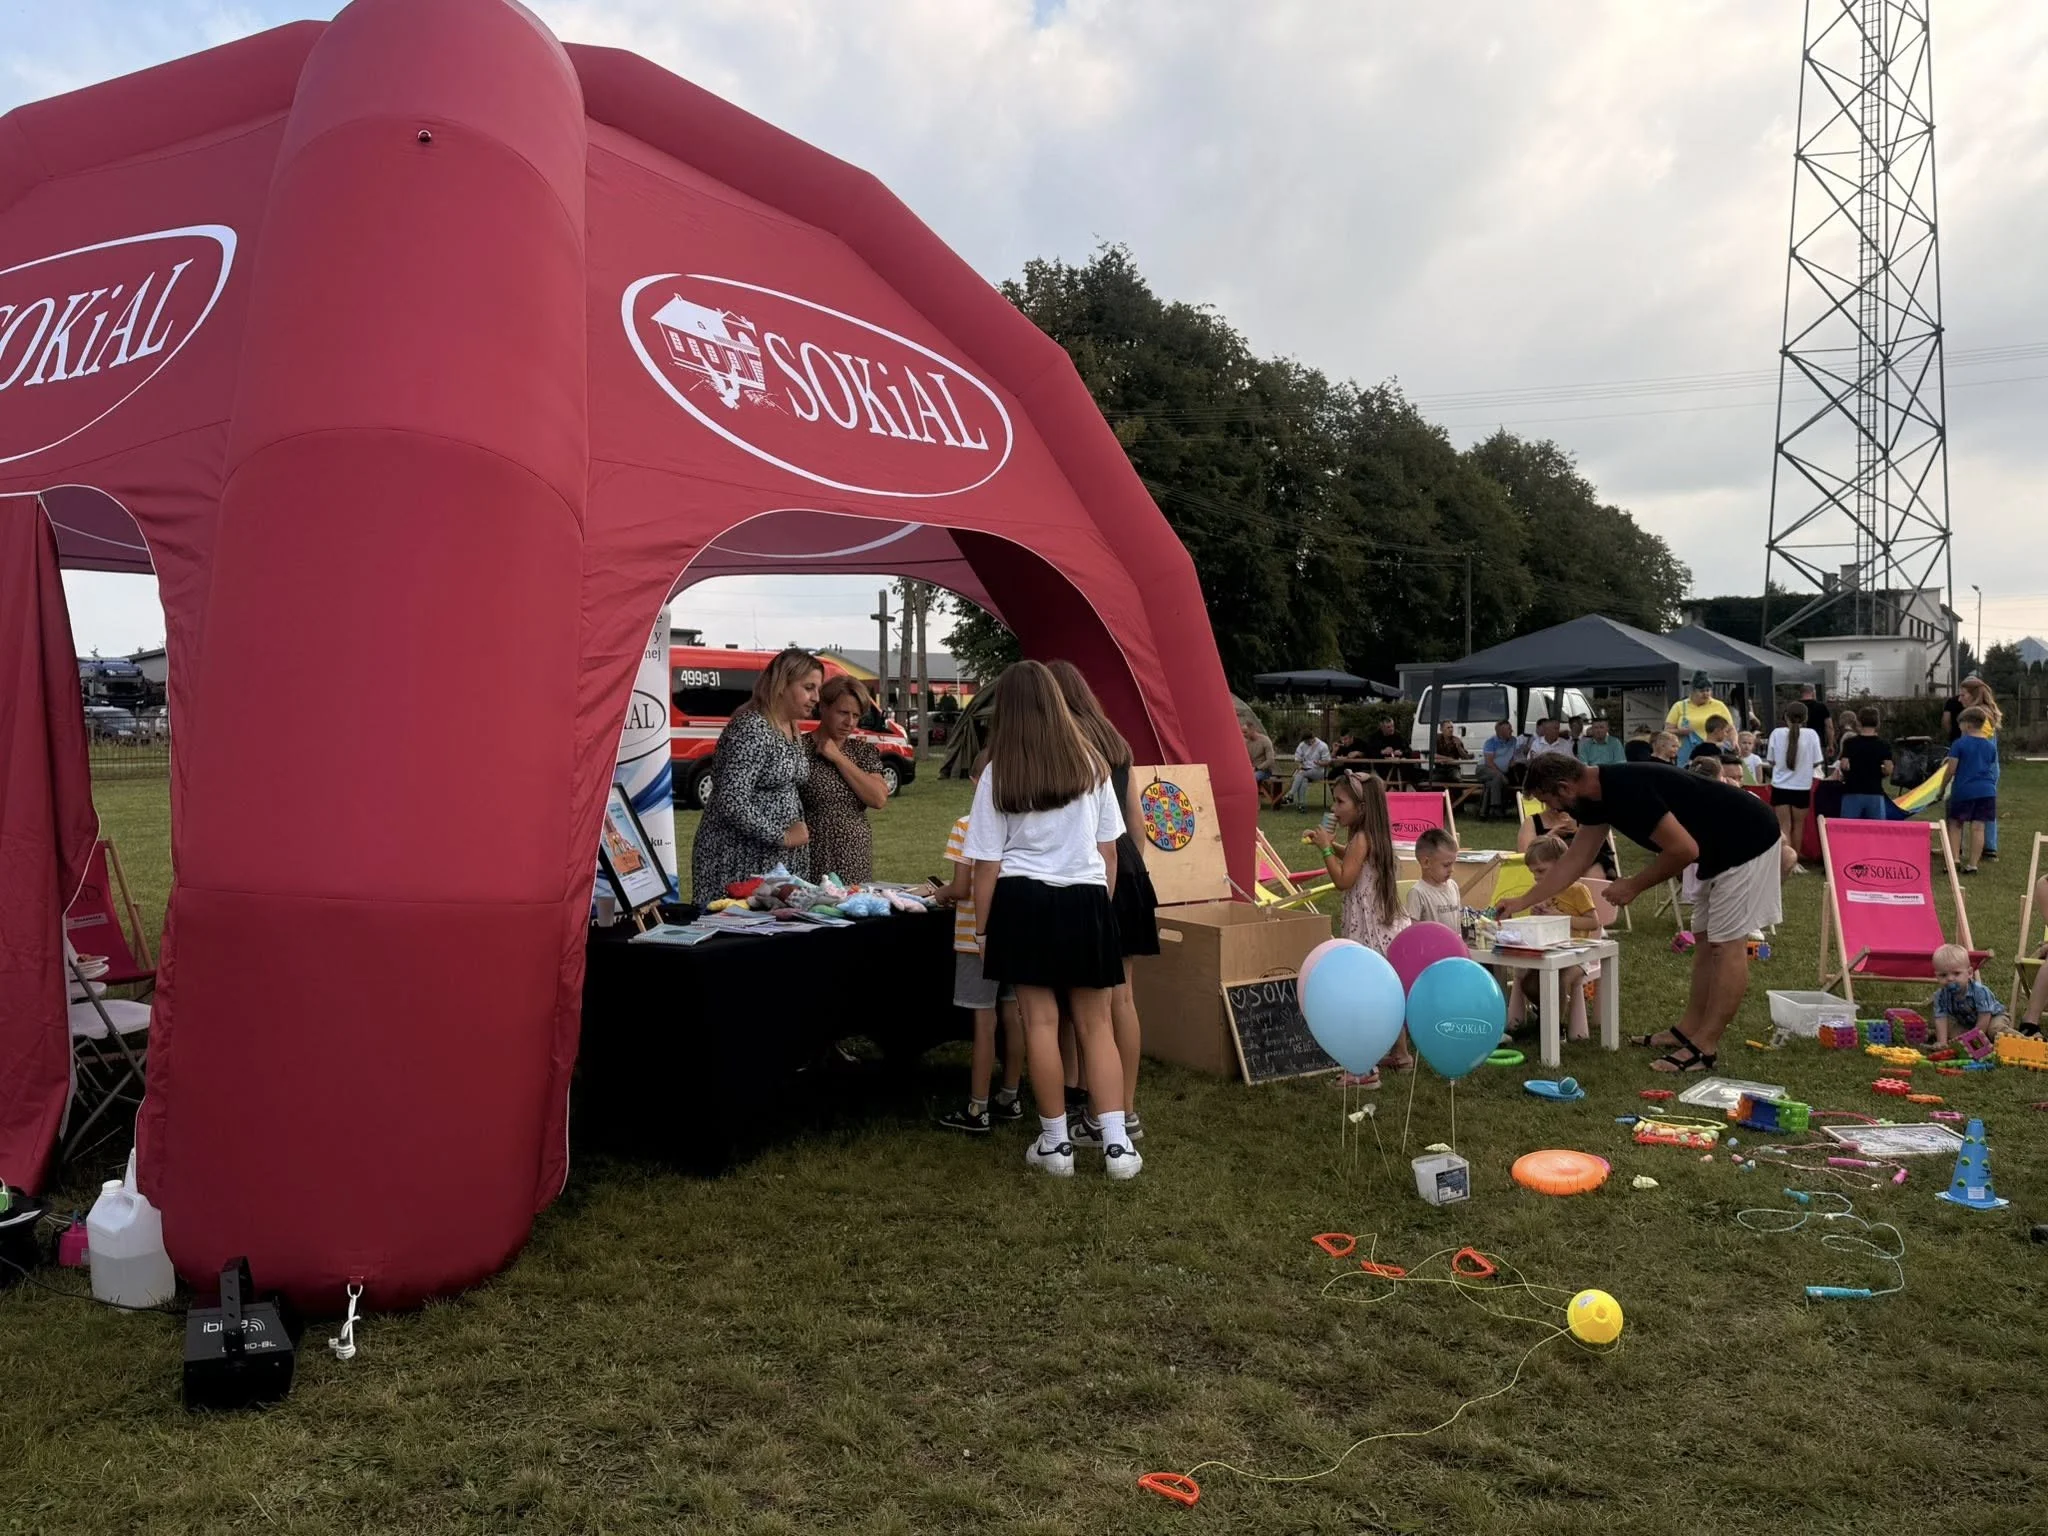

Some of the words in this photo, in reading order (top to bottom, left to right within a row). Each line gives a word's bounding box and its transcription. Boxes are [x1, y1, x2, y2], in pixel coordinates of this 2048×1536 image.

[763, 331, 989, 450] SOKiAL
[1149, 787, 1158, 795] 10
[1165, 786, 1175, 794] 10
[1142, 803, 1151, 811] 10
[1180, 799, 1189, 807] 10
[1185, 819, 1193, 827] 10
[1146, 824, 1155, 832] 10
[1160, 838, 1169, 846] 10
[1178, 835, 1186, 844] 10
[1870, 865, 1913, 880] SOKiAL
[203, 1319, 249, 1334] ibia
